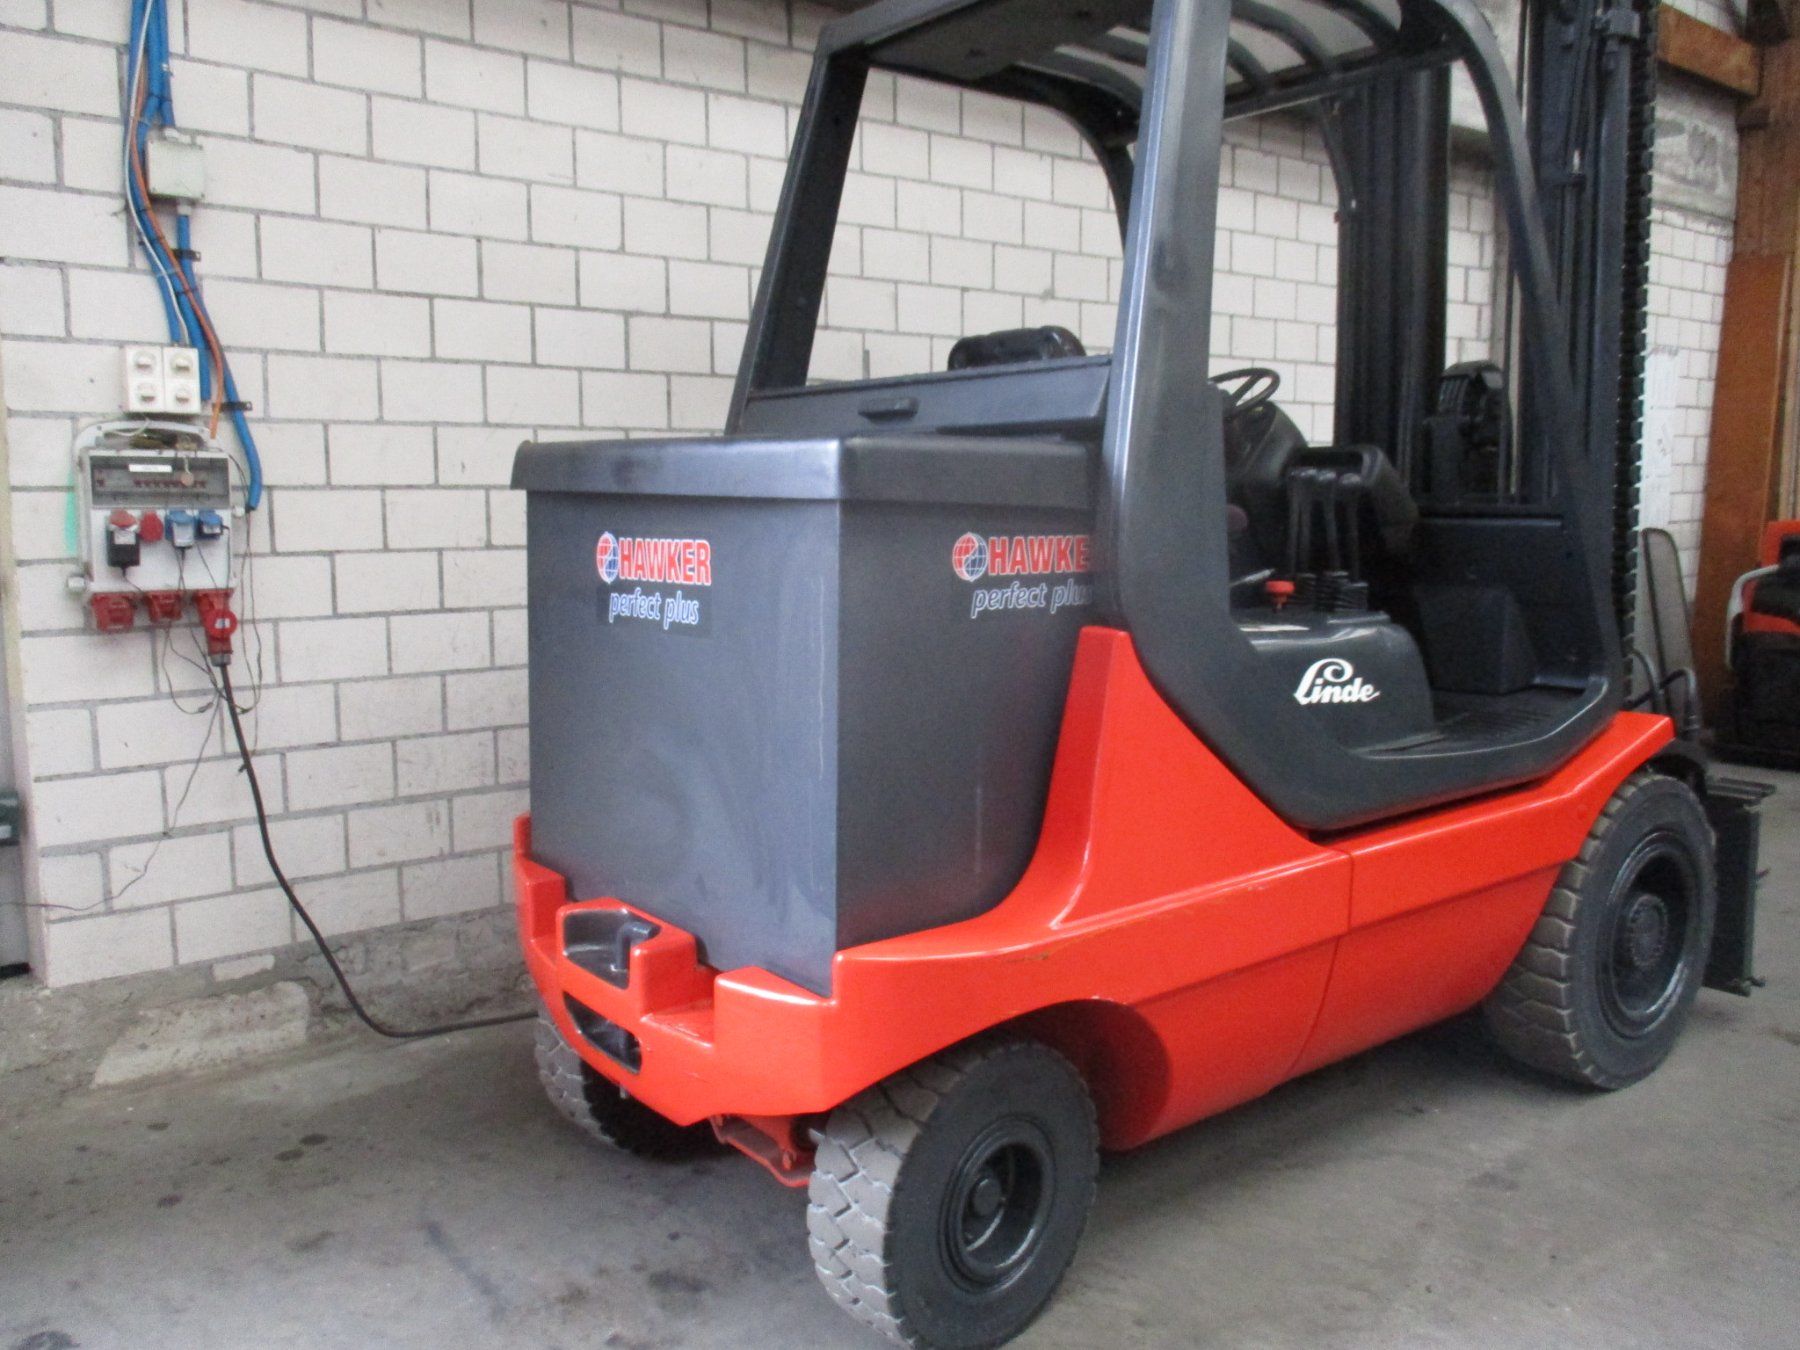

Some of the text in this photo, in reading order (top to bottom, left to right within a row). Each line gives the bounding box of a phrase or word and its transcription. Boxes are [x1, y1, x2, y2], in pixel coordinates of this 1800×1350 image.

[619, 536, 712, 586] HAWKER
[987, 533, 1090, 576] HAWKE
[608, 587, 699, 630] perfect plus
[970, 581, 1047, 620] perfect
[1293, 657, 1381, 705] Linde
